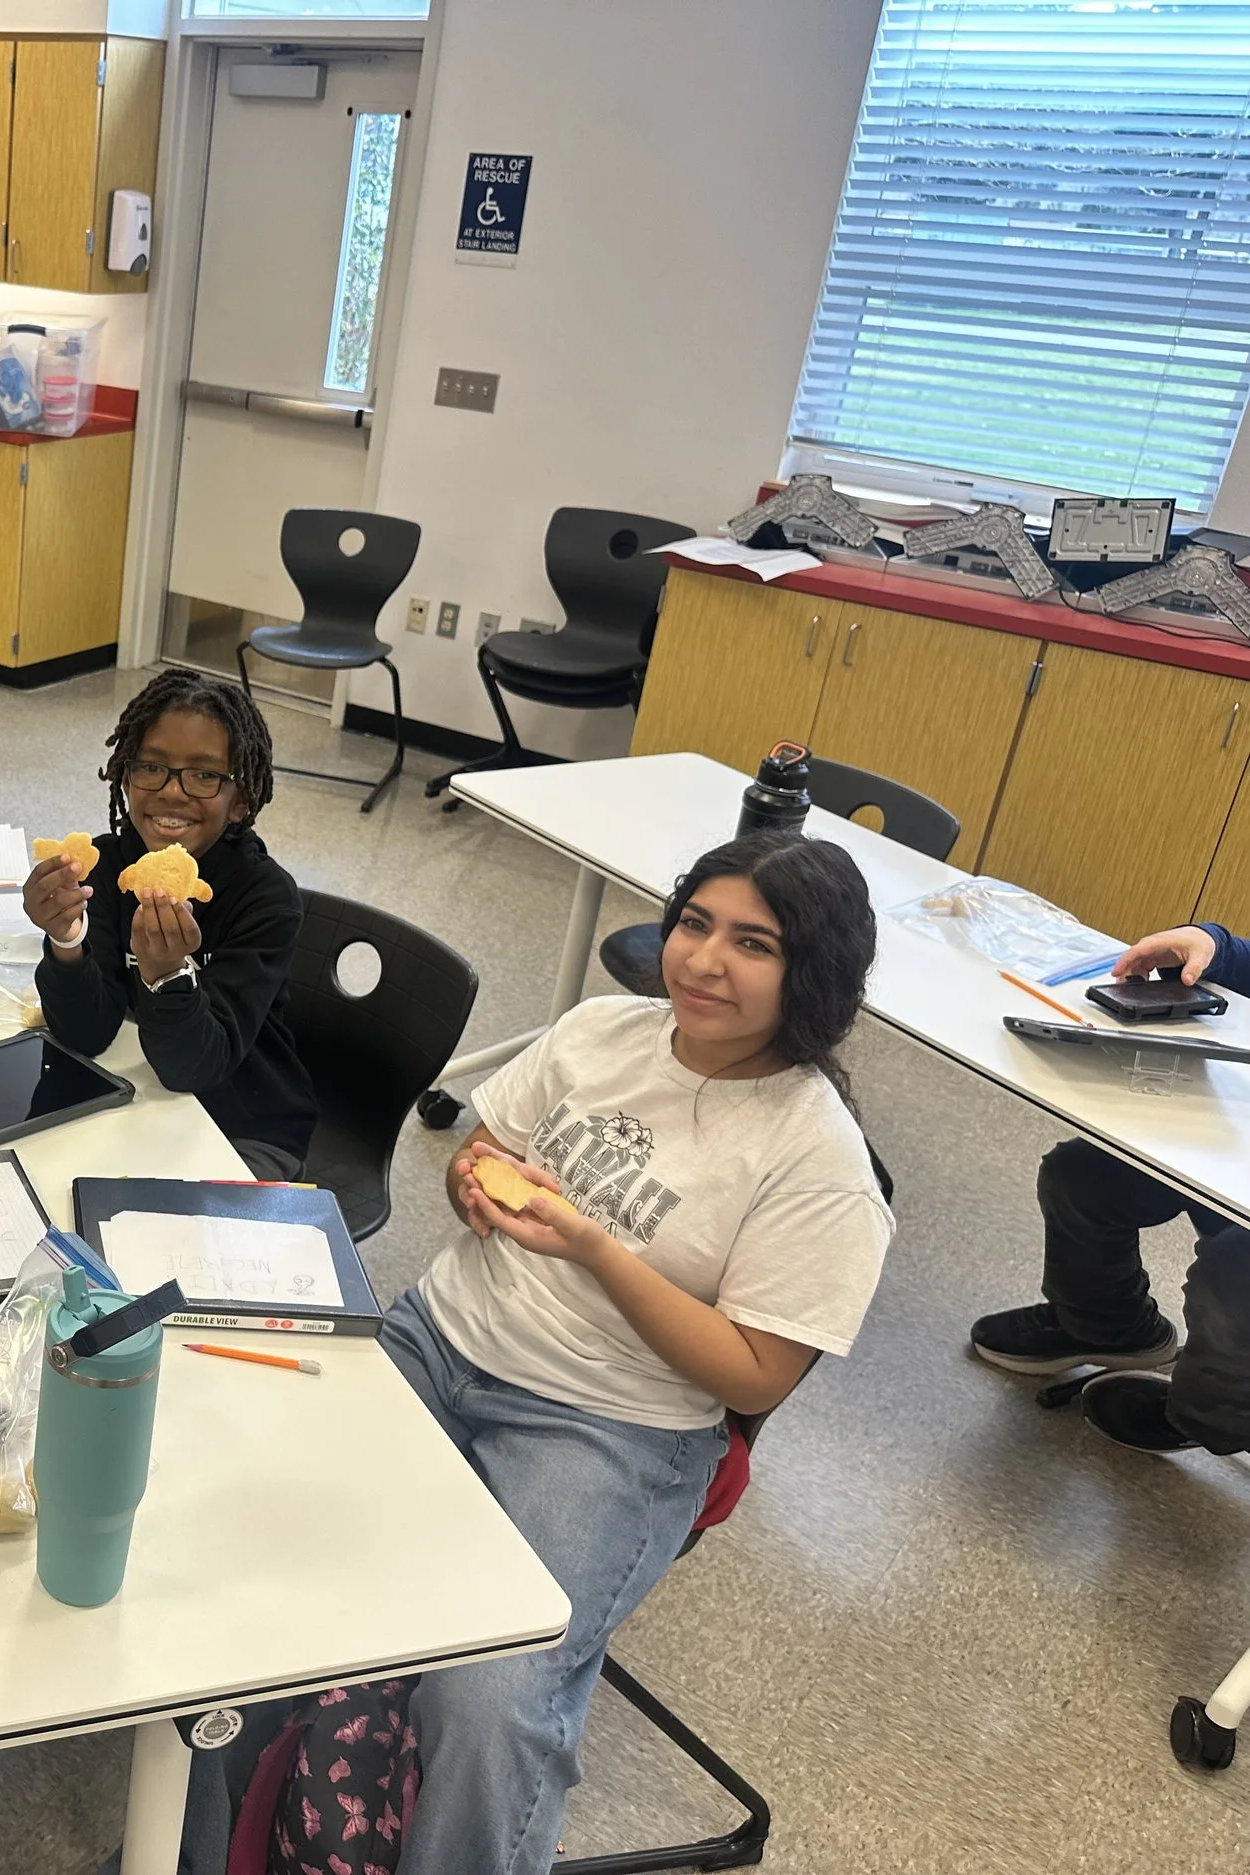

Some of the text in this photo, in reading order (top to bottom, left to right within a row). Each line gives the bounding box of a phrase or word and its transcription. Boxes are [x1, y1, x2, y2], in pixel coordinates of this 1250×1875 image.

[473, 157, 526, 171] AREA OF
[474, 170, 521, 183] RESCUE
[463, 228, 515, 240] AT EXTERIOR
[458, 239, 516, 252] STAIR LANDING
[173, 1315, 239, 1326] DURABLE VIEW
